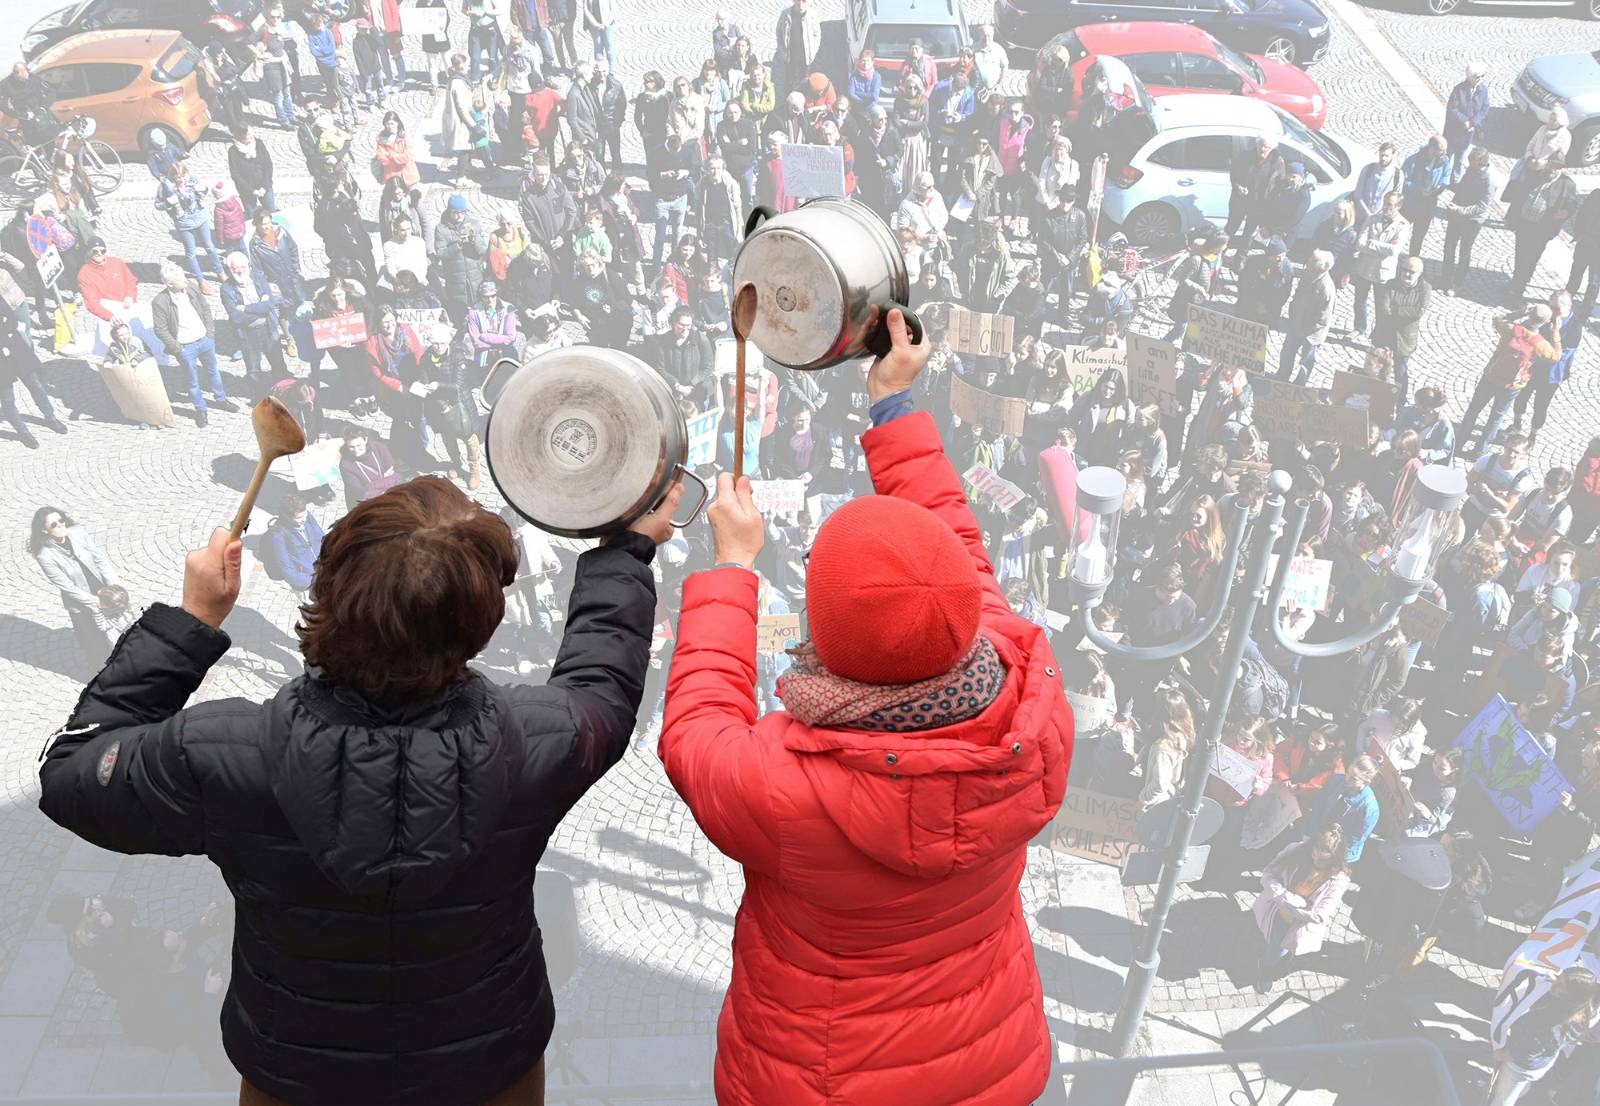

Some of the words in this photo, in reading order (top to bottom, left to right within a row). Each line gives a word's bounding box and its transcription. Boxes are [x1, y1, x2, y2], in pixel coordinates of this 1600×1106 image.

[427, 311, 436, 321] A
[1190, 306, 1217, 327] DAS
[1221, 317, 1266, 342] KLIMA
[1134, 336, 1138, 351] I
[1147, 347, 1167, 361] am
[1066, 348, 1128, 367] Klimaschut
[1145, 358, 1155, 369] a
[773, 626, 800, 637] NOT
